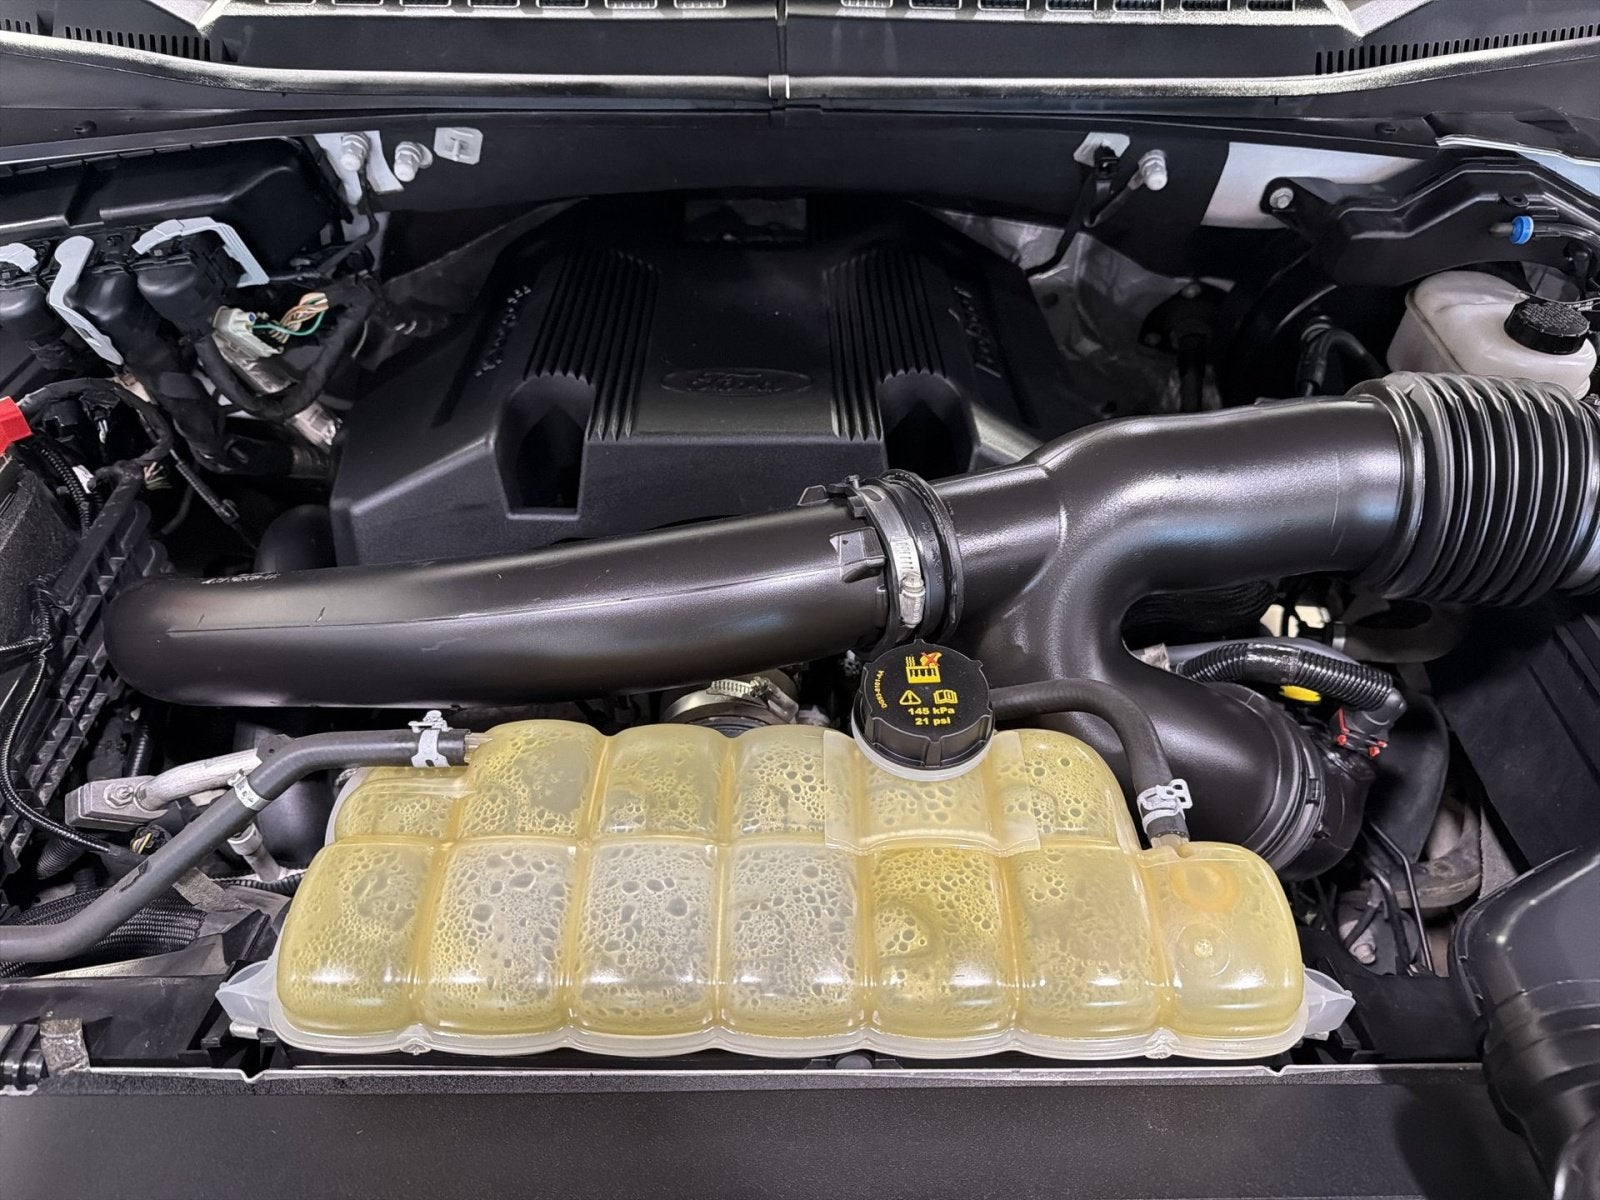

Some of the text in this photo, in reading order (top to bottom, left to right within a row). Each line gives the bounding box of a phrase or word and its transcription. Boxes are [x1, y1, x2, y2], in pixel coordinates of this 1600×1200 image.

[908, 706, 955, 715] 145 kPa
[915, 716, 951, 726] 21 psi
